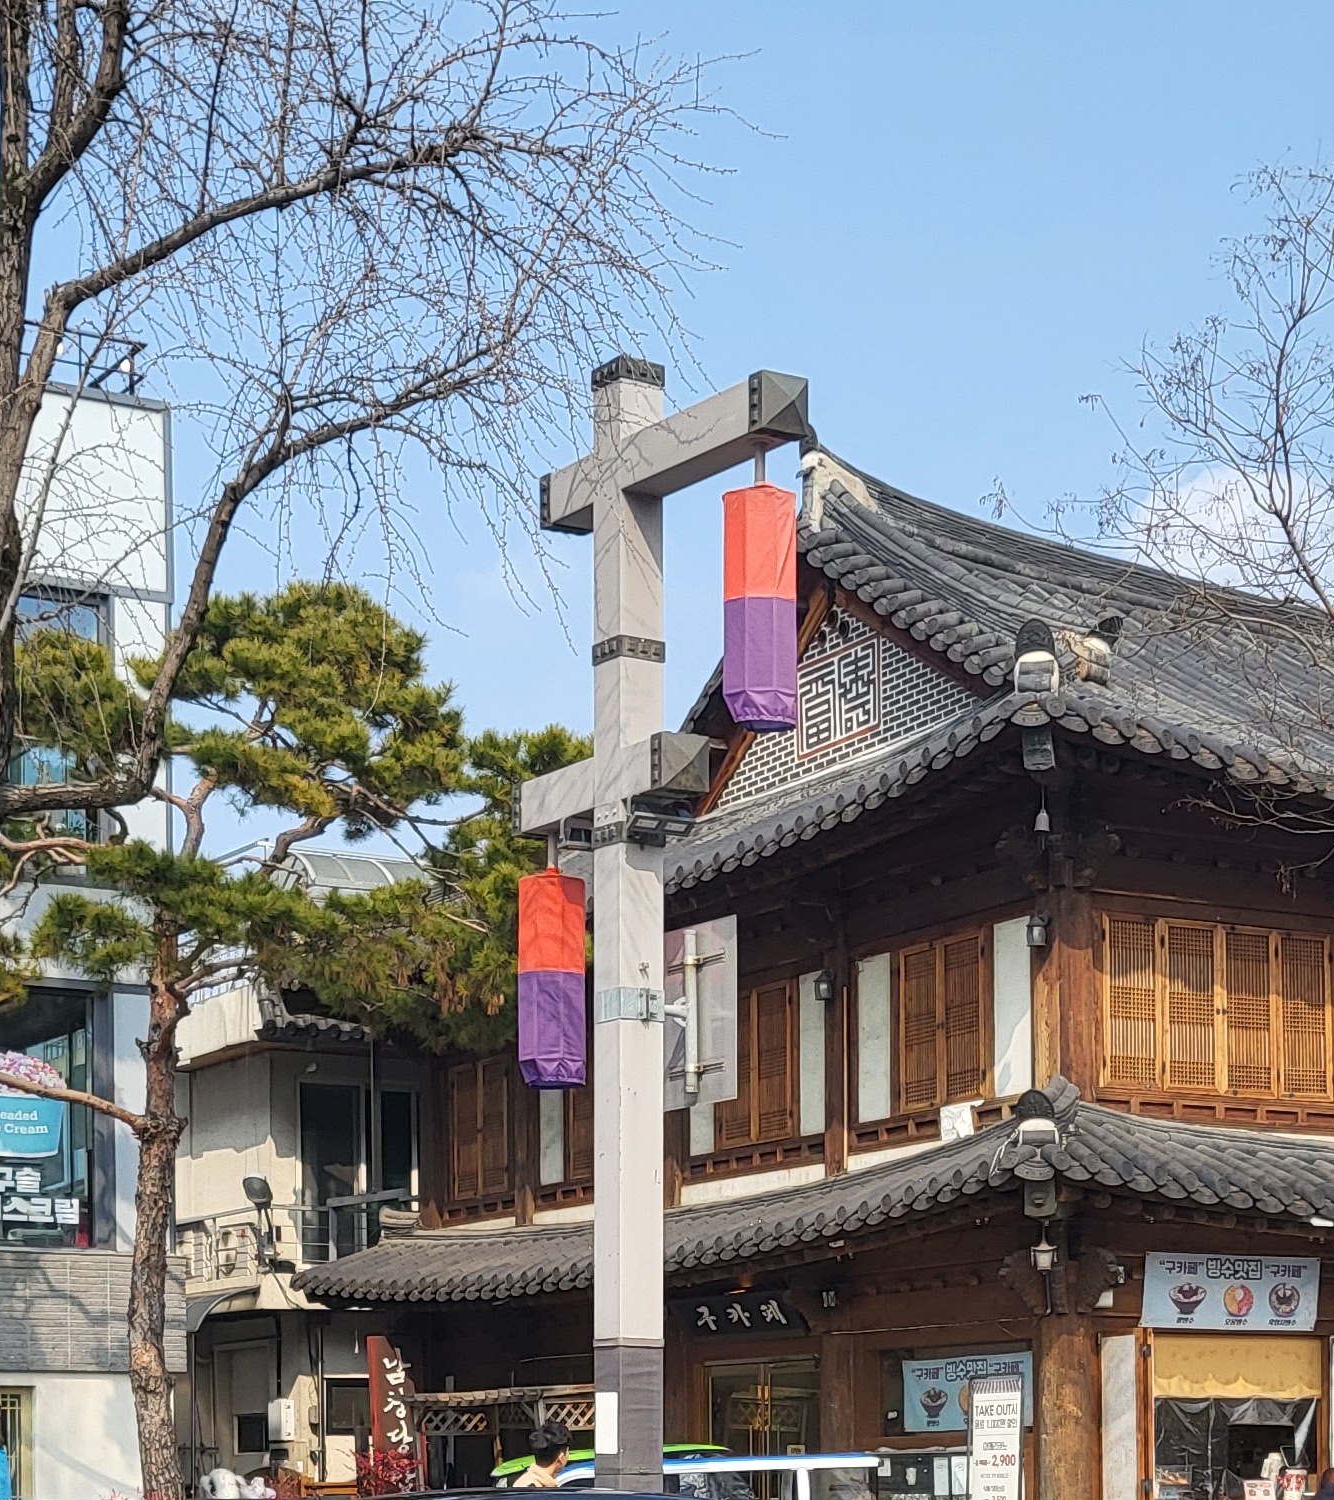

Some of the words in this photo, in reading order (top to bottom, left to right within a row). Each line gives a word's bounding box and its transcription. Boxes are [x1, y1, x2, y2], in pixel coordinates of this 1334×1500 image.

[4, 1123, 49, 1134] Cream
[1206, 1258, 1263, 1280] 빙수맛집
[695, 1299, 788, 1331] 구카페
[381, 1346, 414, 1455] 남창당
[975, 1404, 995, 1417] TAKE
[992, 1454, 1016, 1468] 2,900
